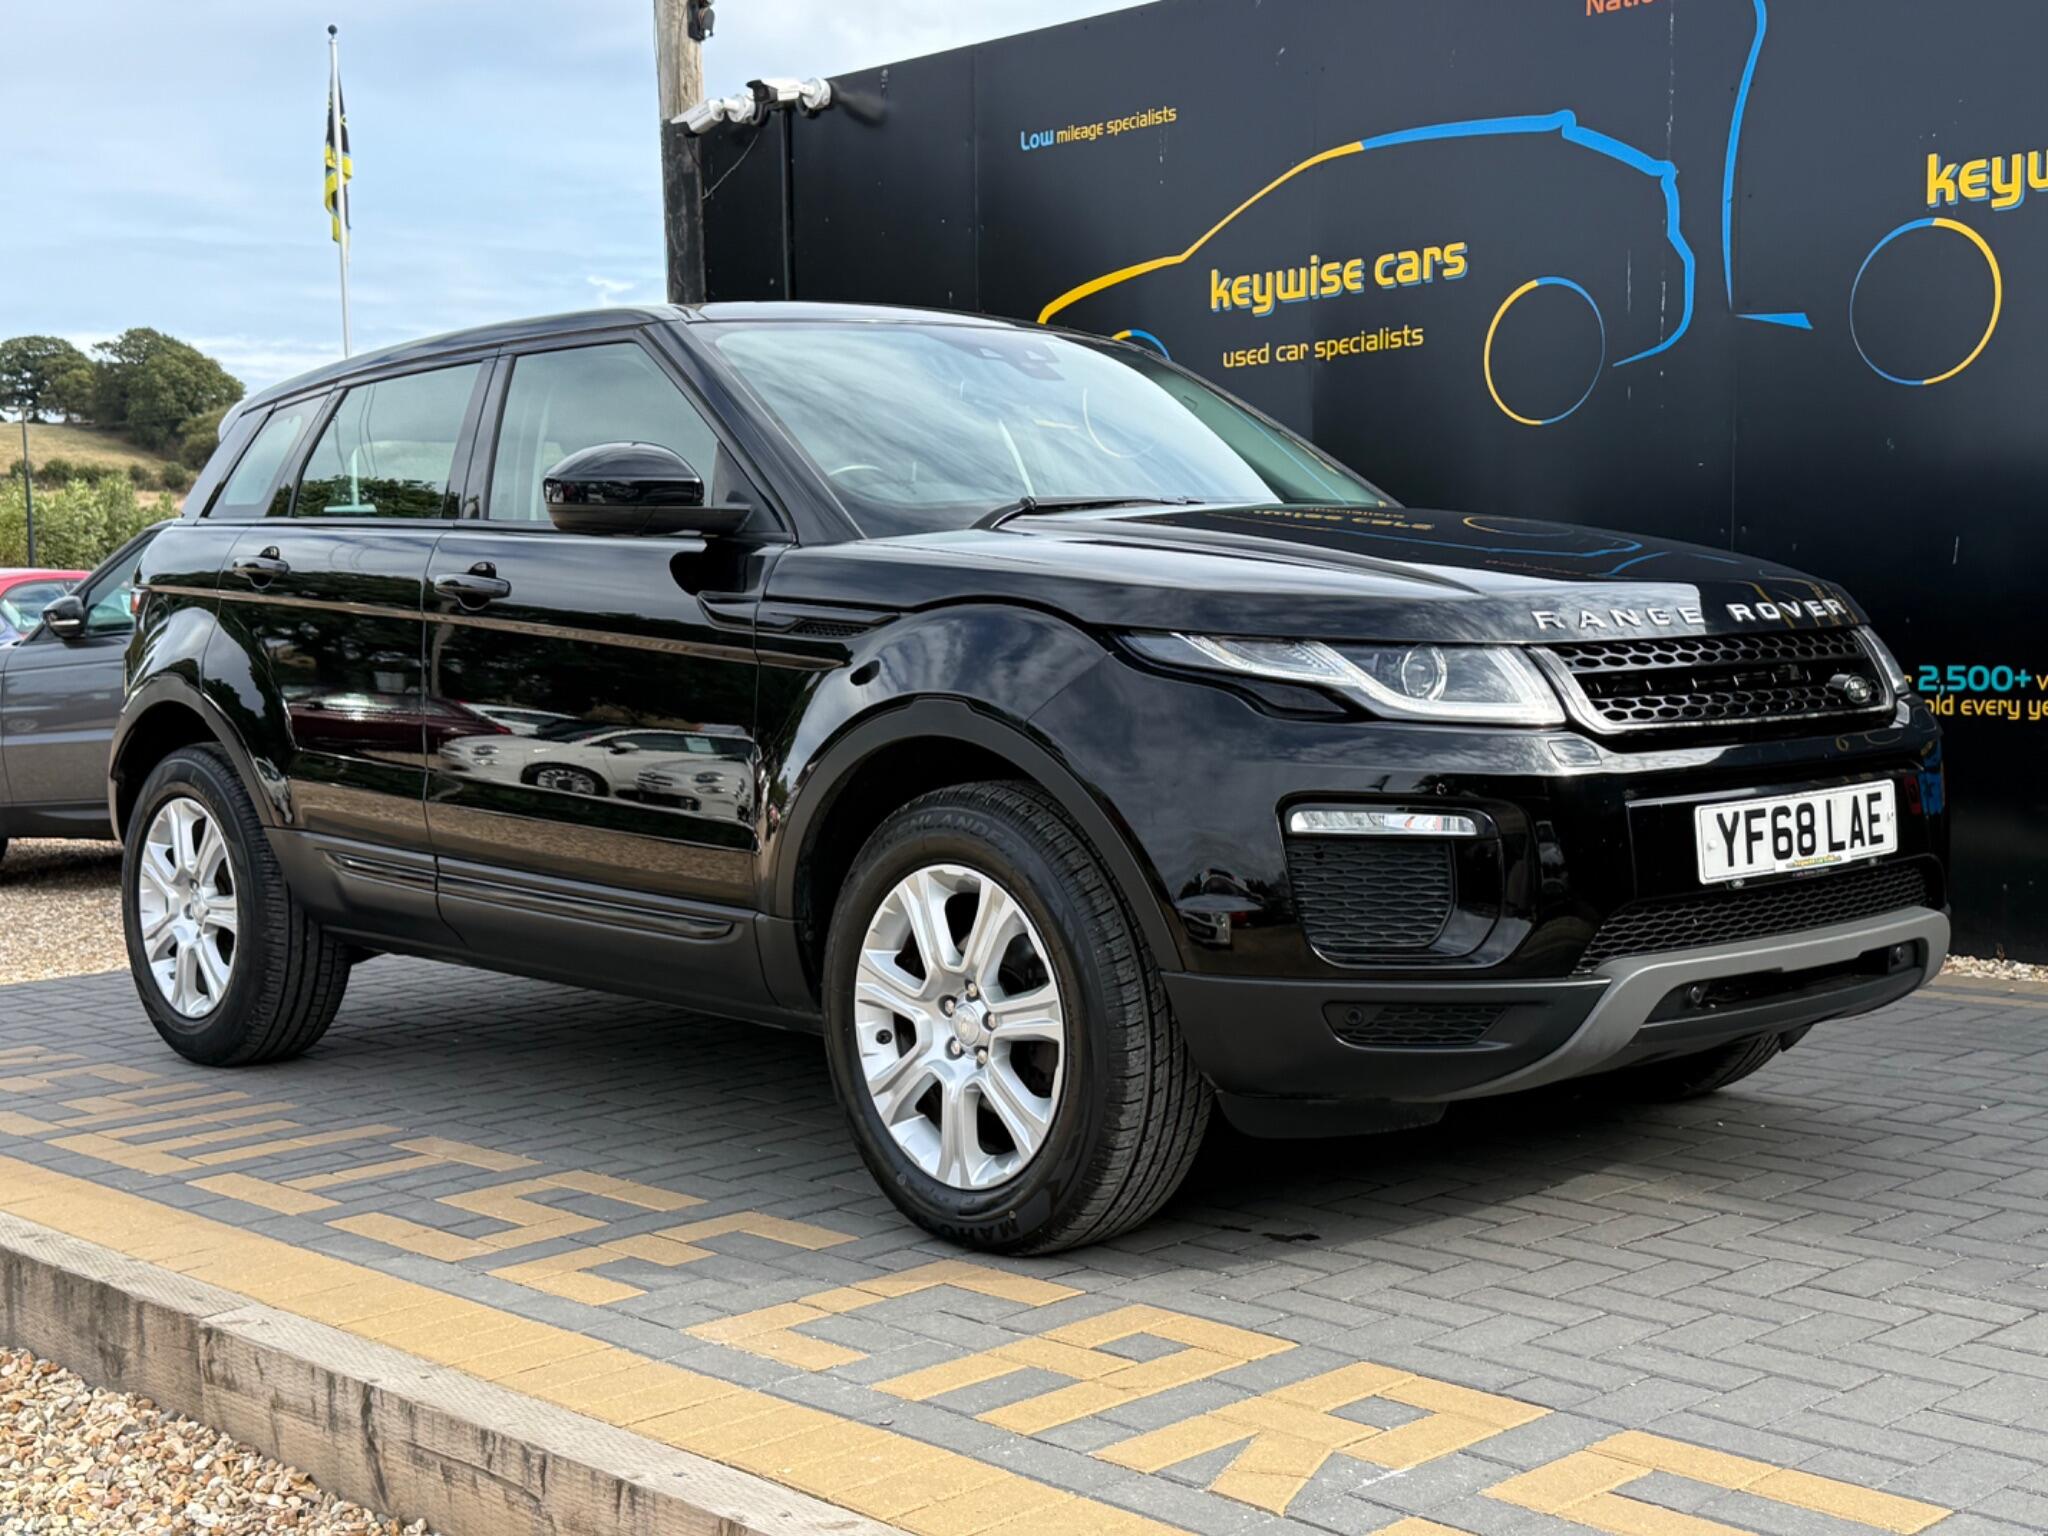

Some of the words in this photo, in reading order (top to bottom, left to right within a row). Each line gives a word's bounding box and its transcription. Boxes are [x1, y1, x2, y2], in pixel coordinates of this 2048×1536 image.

[1021, 129, 1054, 151] Low
[1056, 122, 1103, 144] mileage
[1107, 106, 1177, 136] specialists
[1210, 254, 1364, 317] keywise
[1374, 241, 1468, 290] cars
[1222, 342, 1270, 368] used
[1276, 343, 1310, 363] car
[1314, 324, 1424, 361] specialists
[1531, 606, 1705, 631] RANGE
[1726, 598, 1847, 622] ROVER
[1918, 665, 2032, 696] 2,500+
[1961, 699, 2020, 720] every
[1716, 802, 1817, 868] YF68
[1825, 791, 1884, 853] LAE
